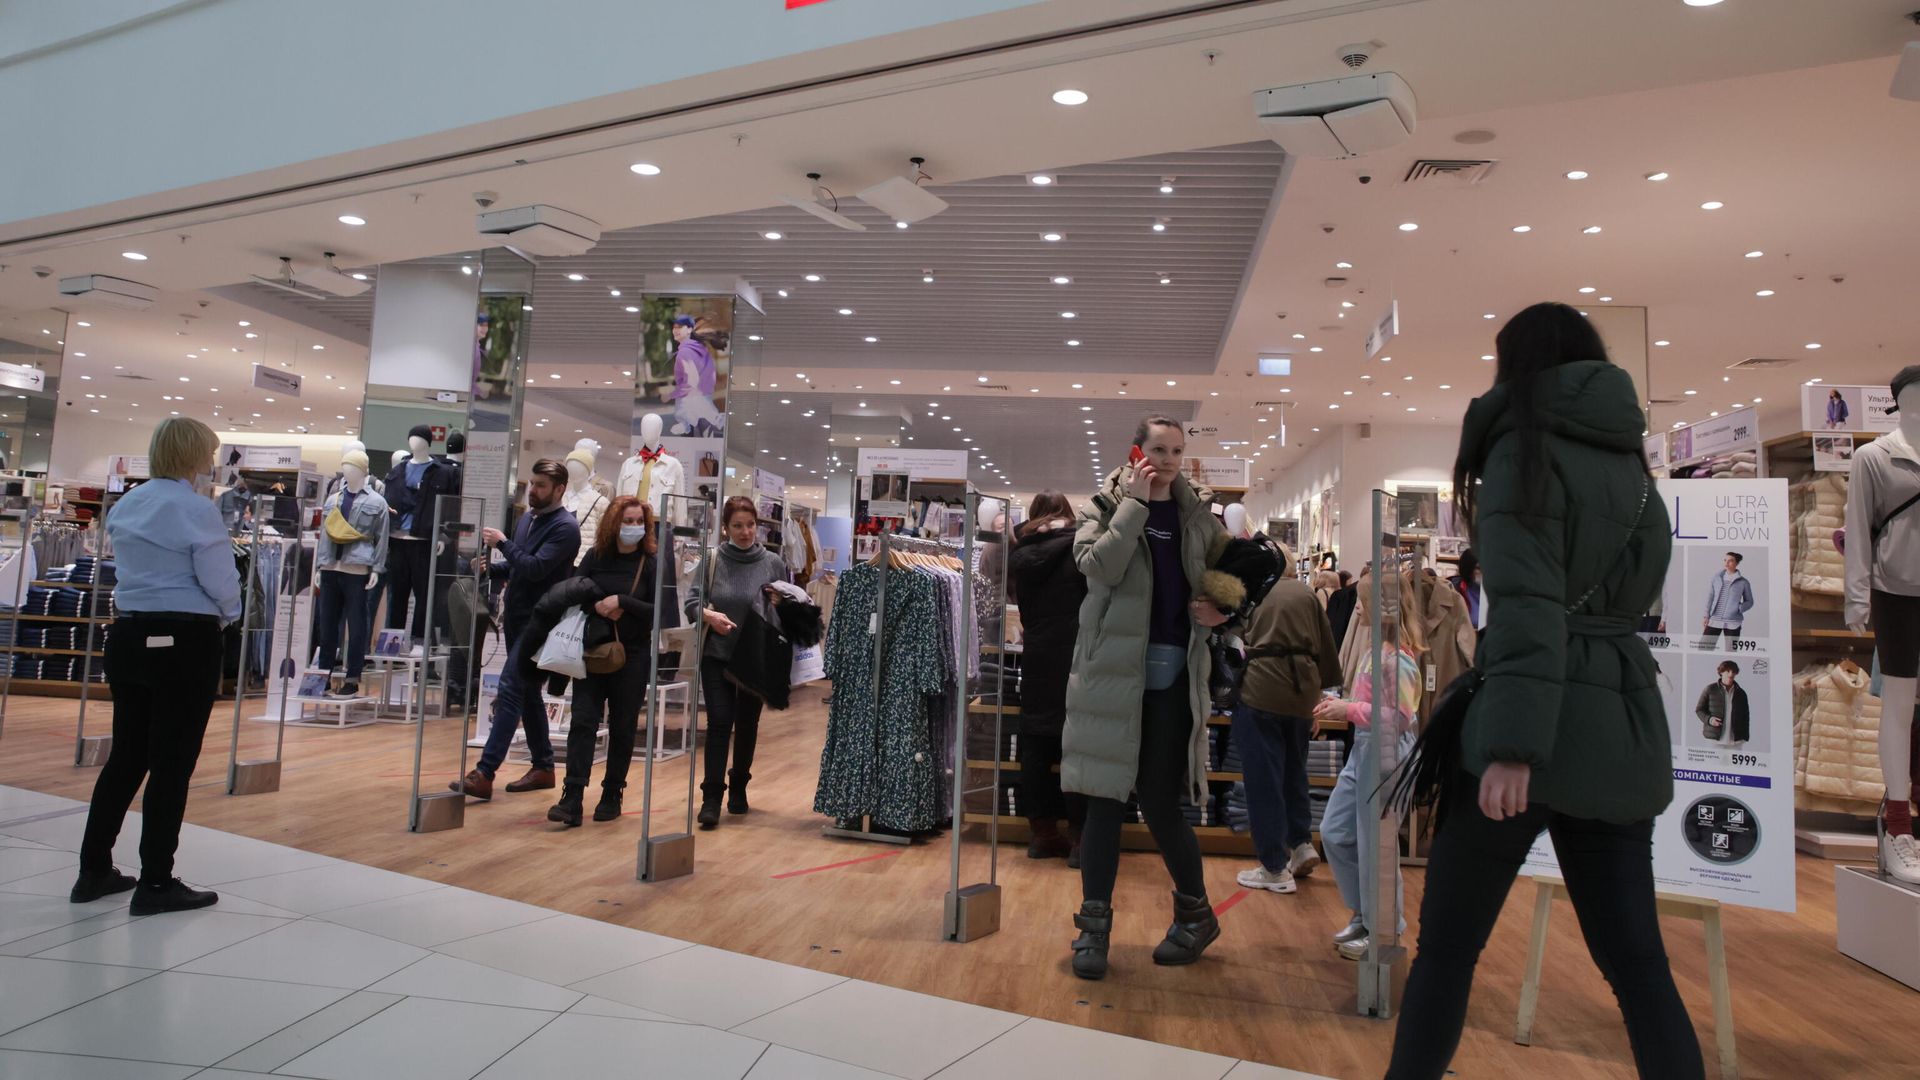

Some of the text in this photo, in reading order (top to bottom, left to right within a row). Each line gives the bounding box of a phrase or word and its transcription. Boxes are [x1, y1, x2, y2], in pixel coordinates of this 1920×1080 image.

[1867, 394, 1897, 402] Ультра
[1868, 405, 1888, 413] пухо
[1733, 426, 1747, 441] 2999
[1715, 495, 1769, 509] ULTRA
[1715, 510, 1769, 525] LIGHT
[1715, 526, 1770, 541] DOWN
[1648, 636, 1671, 647] 4999
[1732, 640, 1756, 651] 5999
[1731, 754, 1757, 767] 5999
[1672, 771, 1741, 784] КОМПАКТНЫЕ
